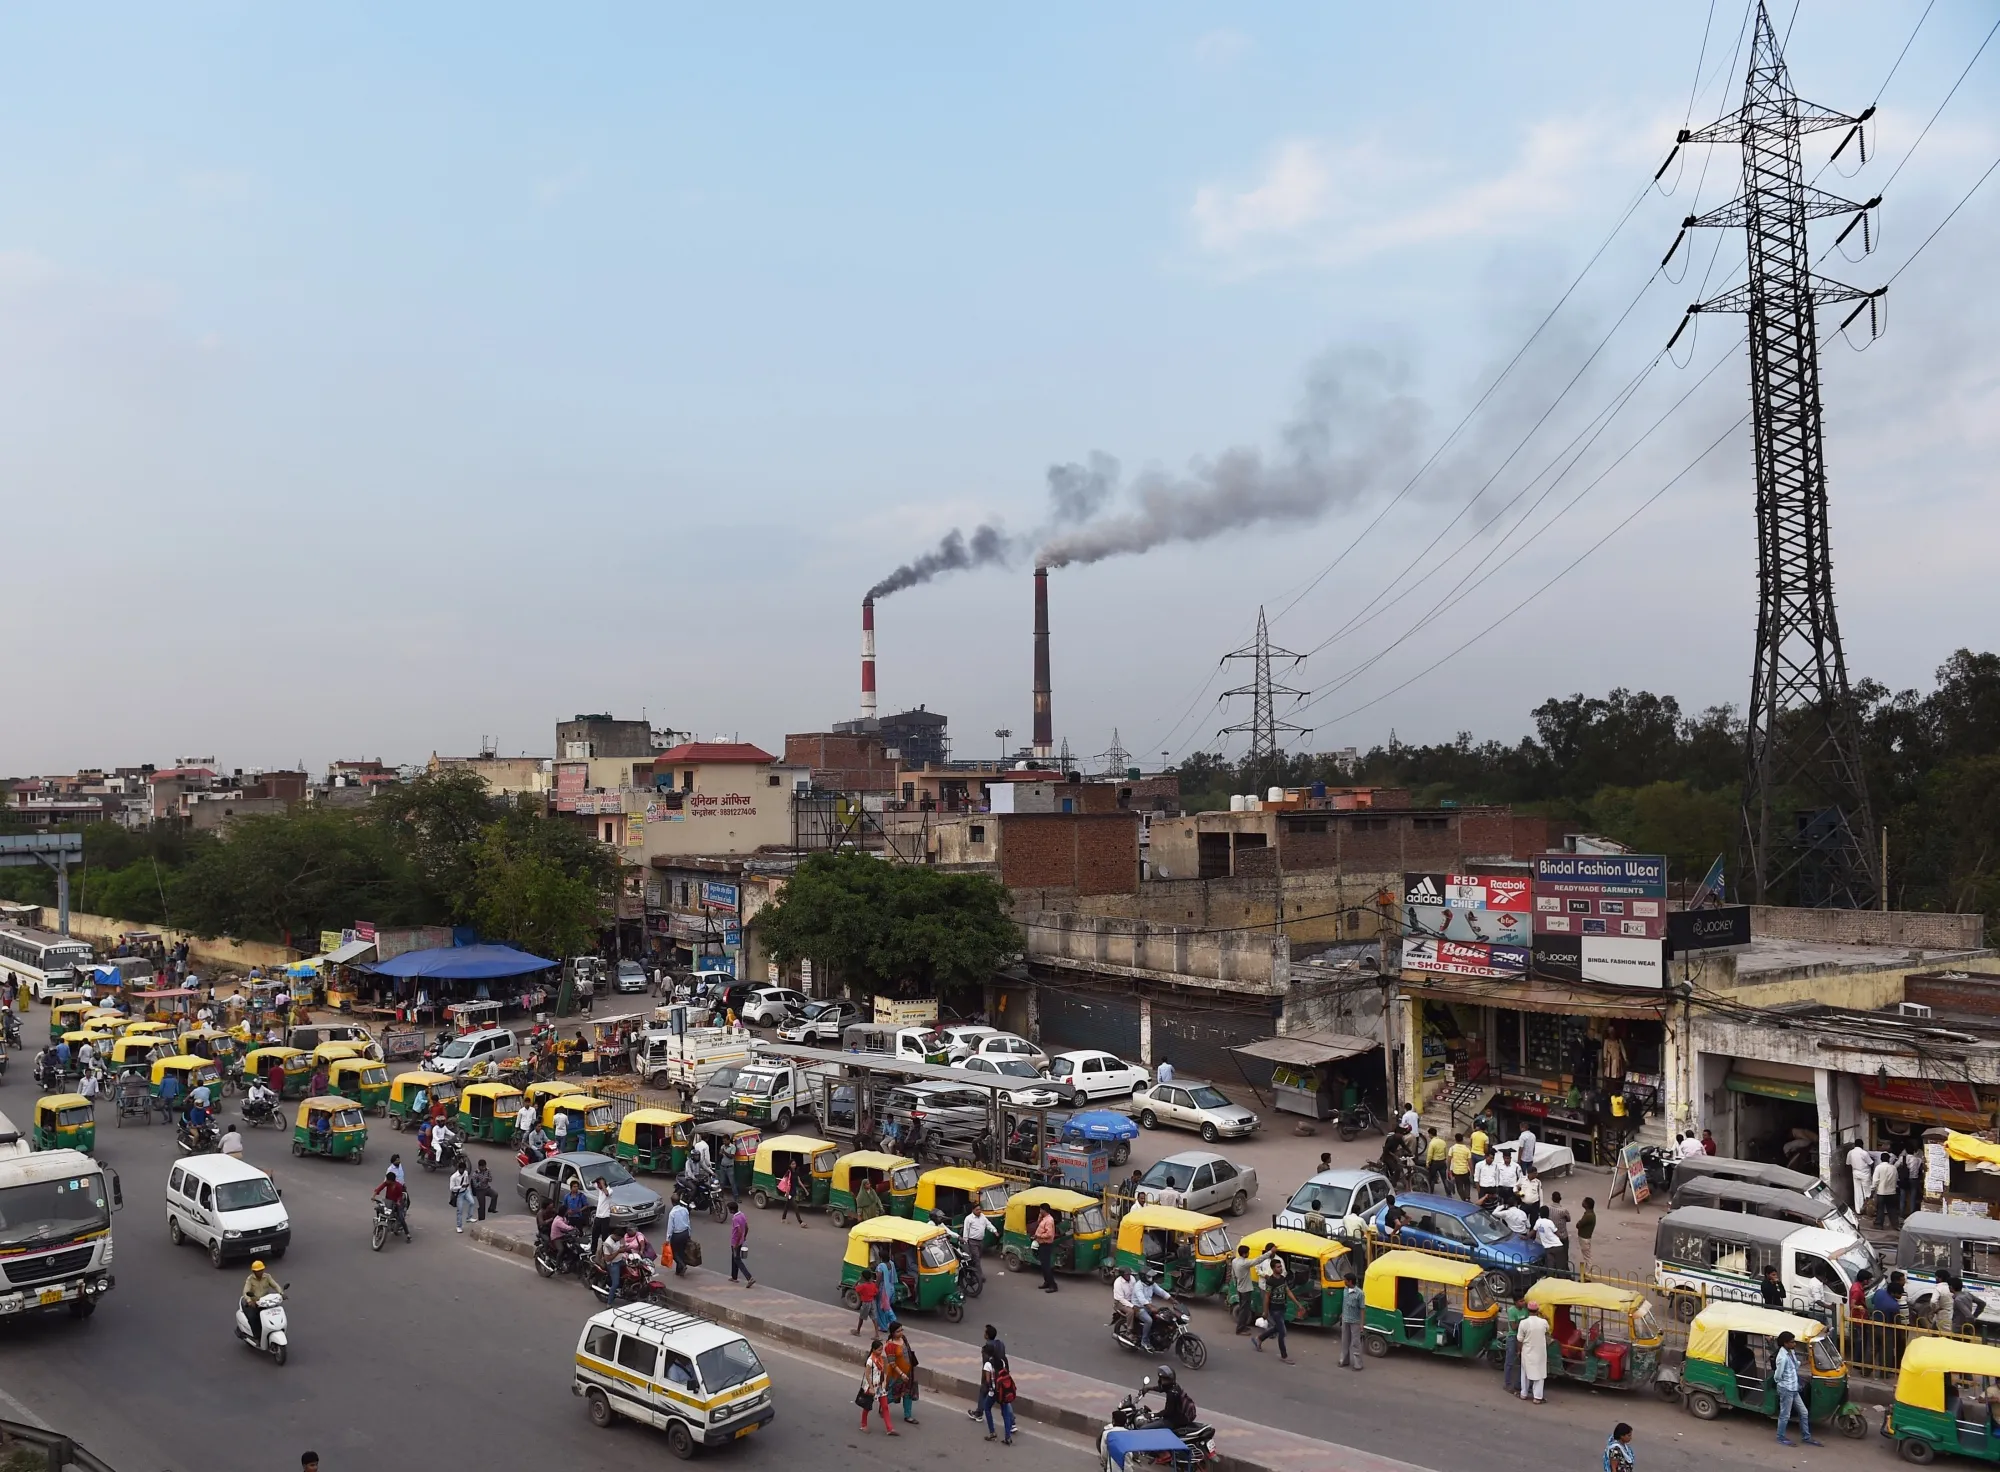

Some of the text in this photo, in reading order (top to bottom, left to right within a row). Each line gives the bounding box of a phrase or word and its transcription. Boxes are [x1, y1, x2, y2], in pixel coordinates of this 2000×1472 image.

[691, 793, 751, 807] यूनियन ऑफिस
[1540, 860, 1659, 876] Bindal Fashion Wear
[1453, 875, 1478, 886] RED
[1490, 879, 1526, 890] Reebok
[1554, 884, 1644, 894] READYMADE GARMENTS
[1406, 893, 1443, 905] adidas
[1451, 900, 1480, 909] CHIEF
[1703, 920, 1734, 932] JOCKEY
[1406, 952, 1433, 960] POWER
[1441, 942, 1487, 958] Bata
[1417, 961, 1450, 970] SHOE
[1453, 965, 1495, 975] TRACK
[731, 1384, 754, 1398] MAXI CAB
